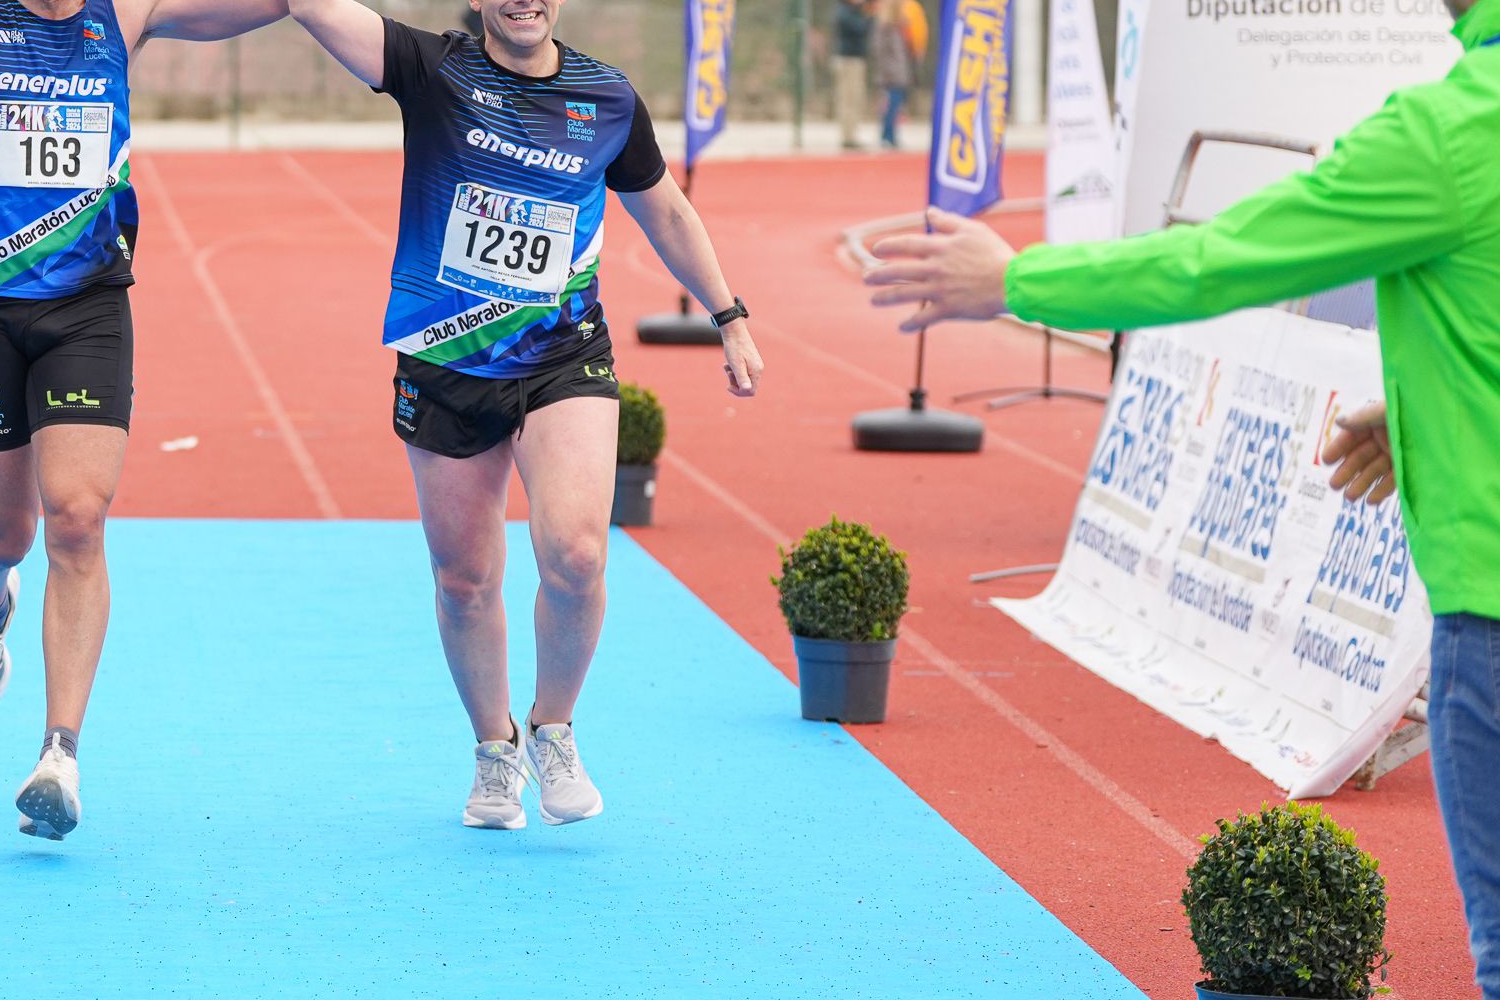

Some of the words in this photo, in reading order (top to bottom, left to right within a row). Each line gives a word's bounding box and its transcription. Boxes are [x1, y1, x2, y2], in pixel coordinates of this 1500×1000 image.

[1237, 27, 1342, 46] Delegación
[1287, 48, 1385, 65] Protección
[486, 92, 503, 101] RUN
[487, 100, 503, 109] PRO
[950, 11, 996, 179] CASH
[567, 120, 585, 128] Club
[567, 125, 596, 136] Maratón
[567, 133, 593, 142] Lucena
[20, 136, 81, 177] 163
[466, 128, 584, 174] enerplus
[8, 211, 71, 253] Maratón
[465, 220, 551, 275] 1239
[423, 322, 457, 345] Club
